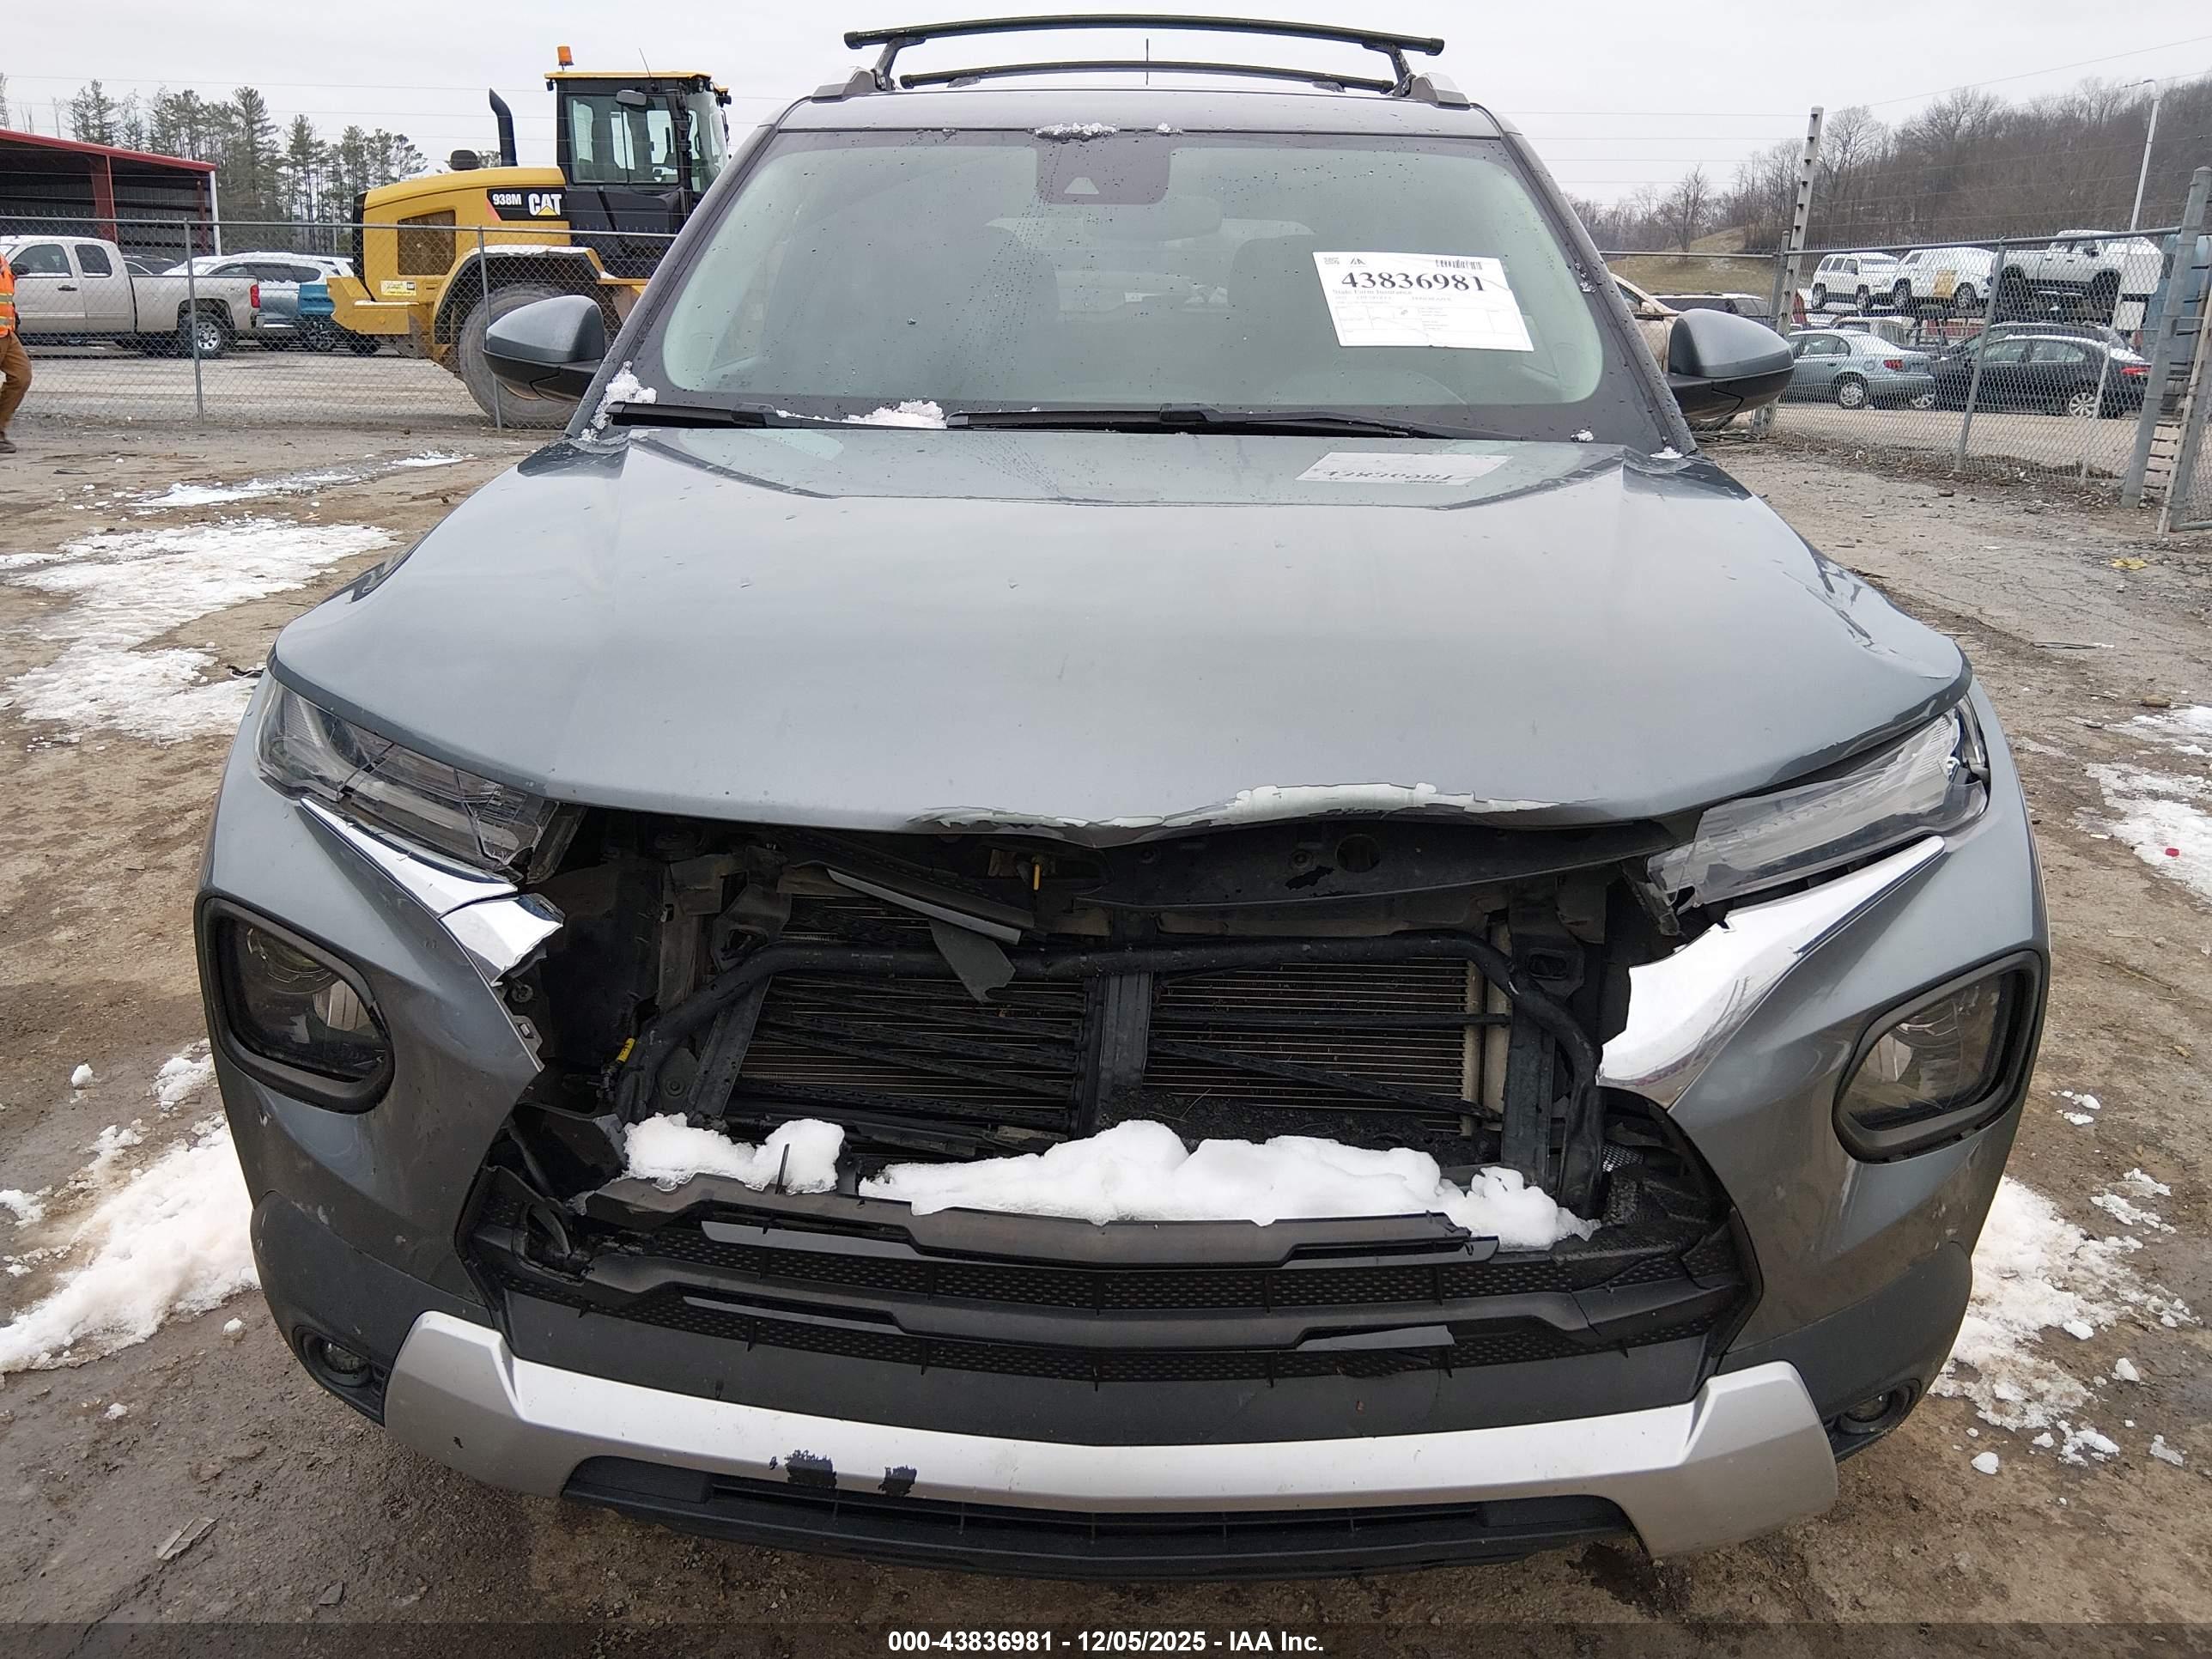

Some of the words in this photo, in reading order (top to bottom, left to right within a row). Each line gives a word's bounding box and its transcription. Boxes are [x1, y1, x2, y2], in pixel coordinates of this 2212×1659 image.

[492, 193, 522, 205] 938M
[528, 193, 562, 216] CAT
[1341, 271, 1486, 292] 43836981
